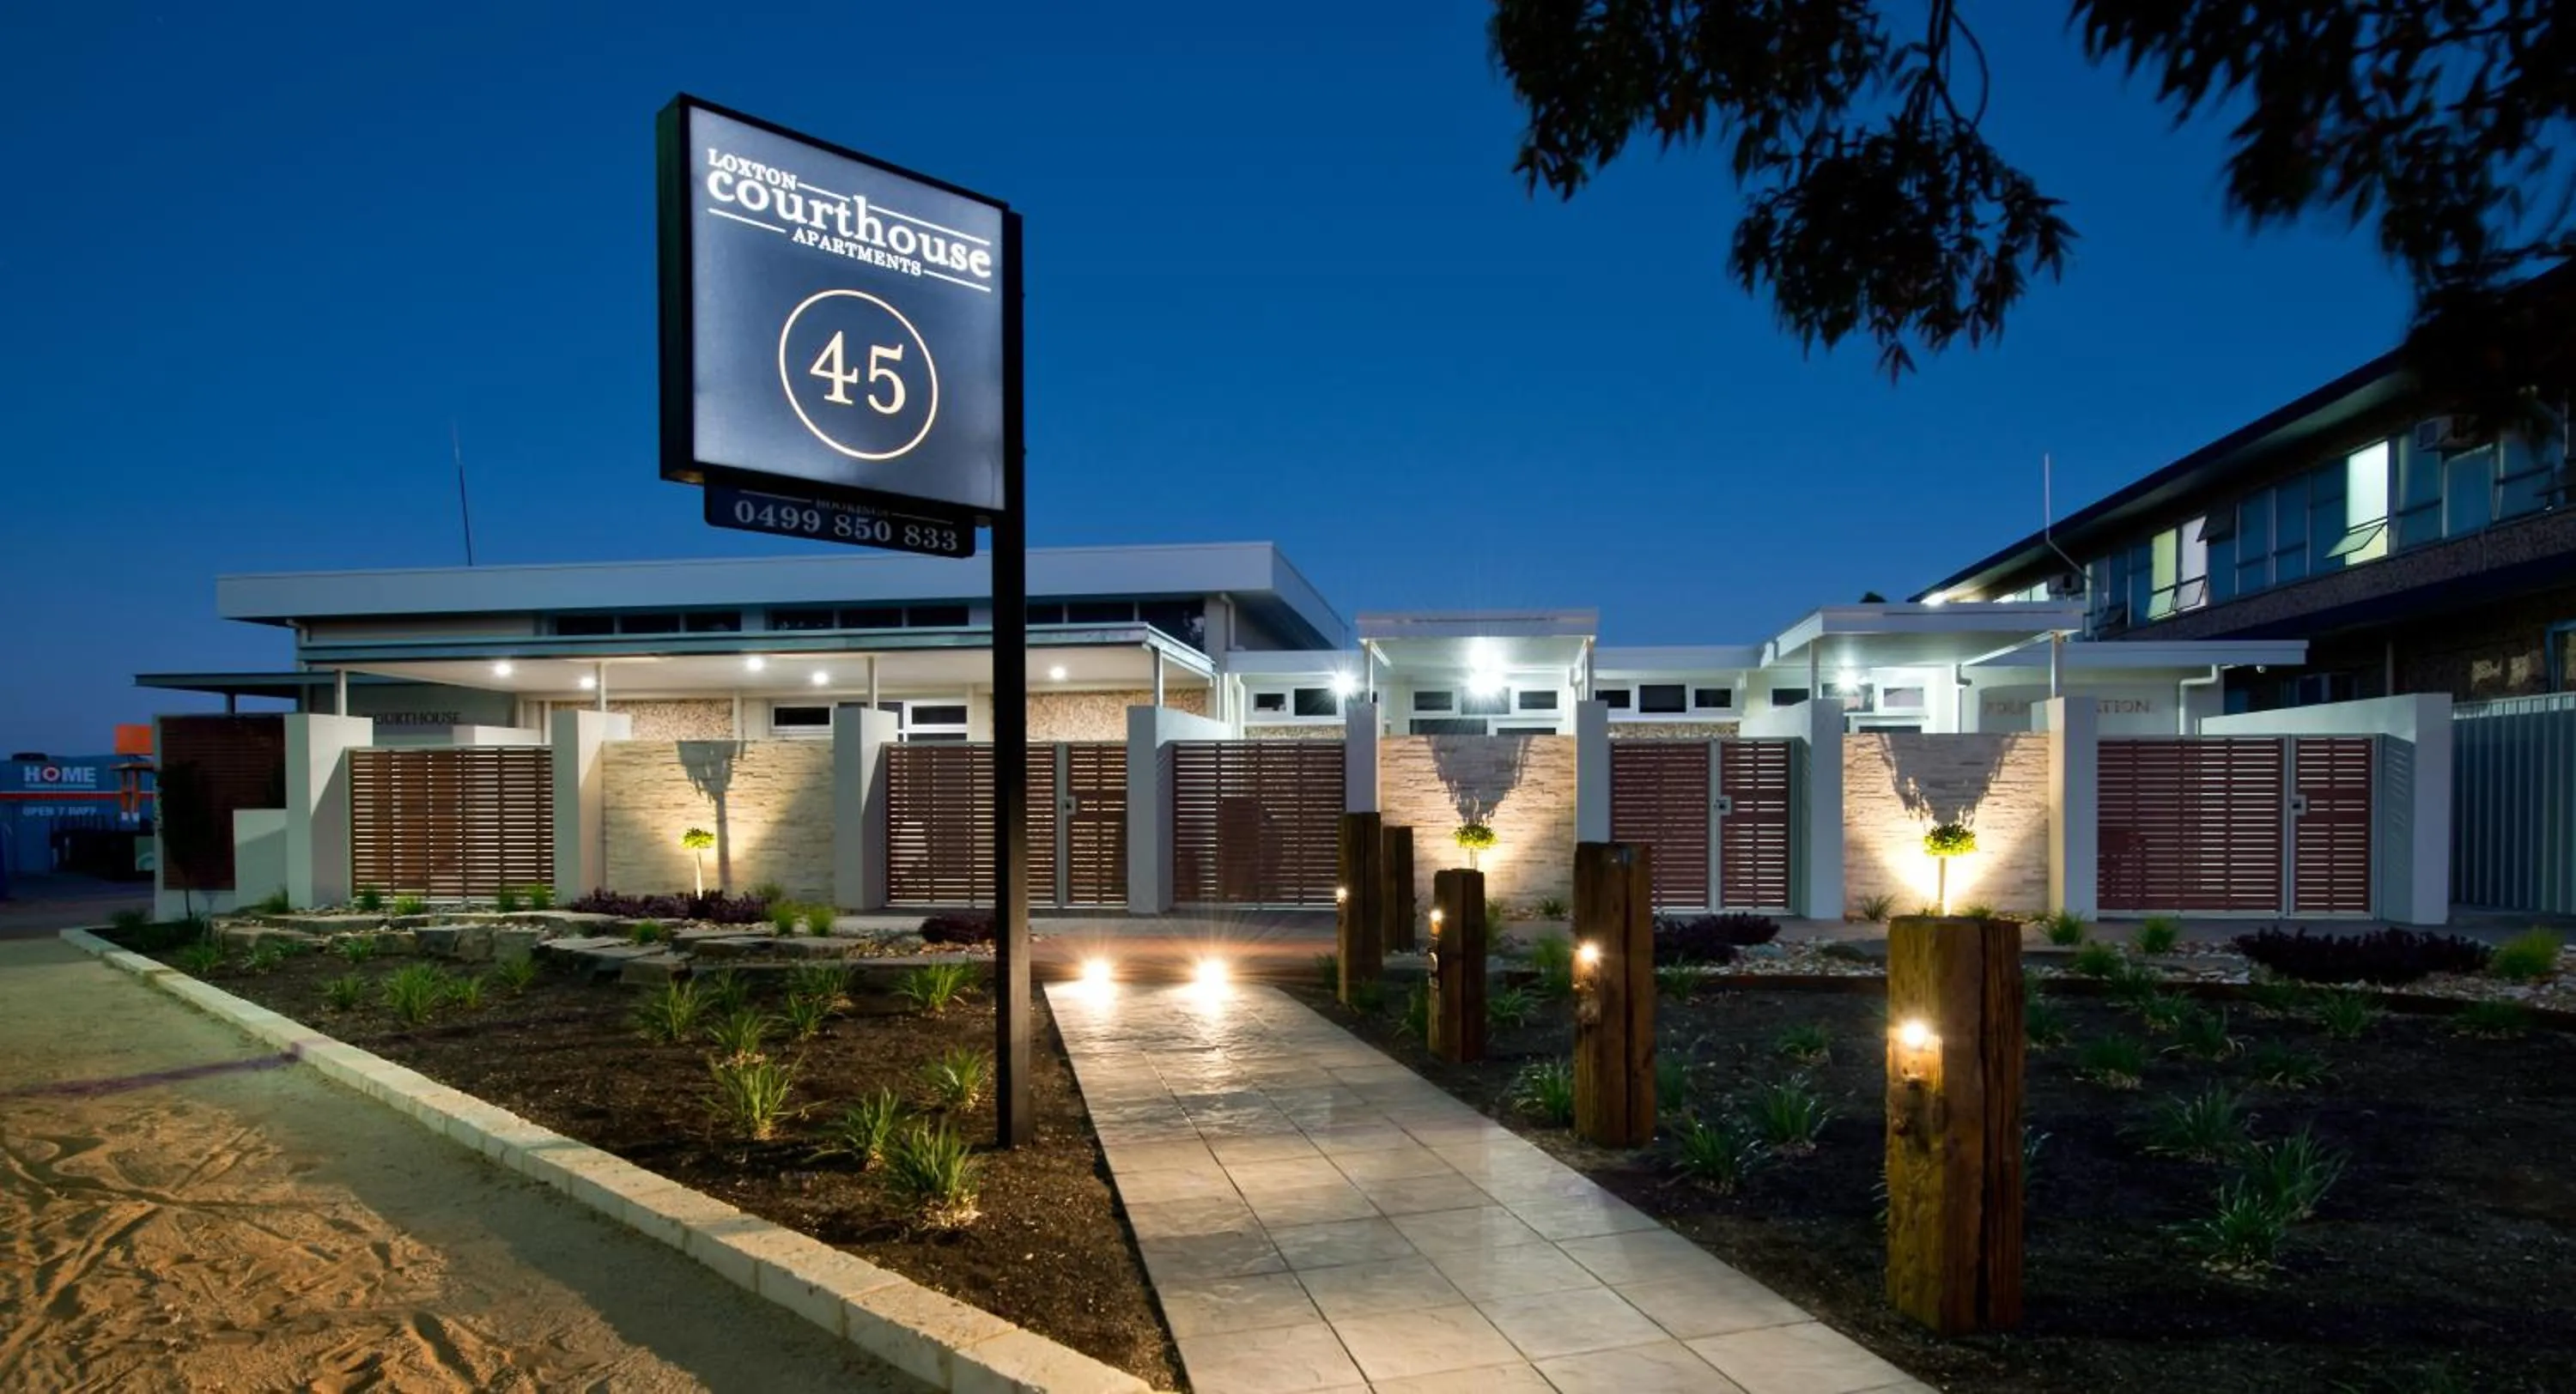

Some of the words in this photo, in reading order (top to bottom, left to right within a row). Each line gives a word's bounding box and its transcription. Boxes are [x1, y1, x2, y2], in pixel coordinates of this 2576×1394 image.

[708, 148, 798, 191] LOXTON
[707, 168, 992, 277] courthouse
[793, 226, 922, 276] APARTMENTS
[810, 330, 907, 415] 45
[733, 500, 822, 533] 0499
[833, 513, 892, 542] 850
[903, 524, 959, 551] 833
[369, 711, 462, 725] OURTHOUSE
[23, 765, 97, 783] HOME
[22, 805, 55, 816] OPEN
